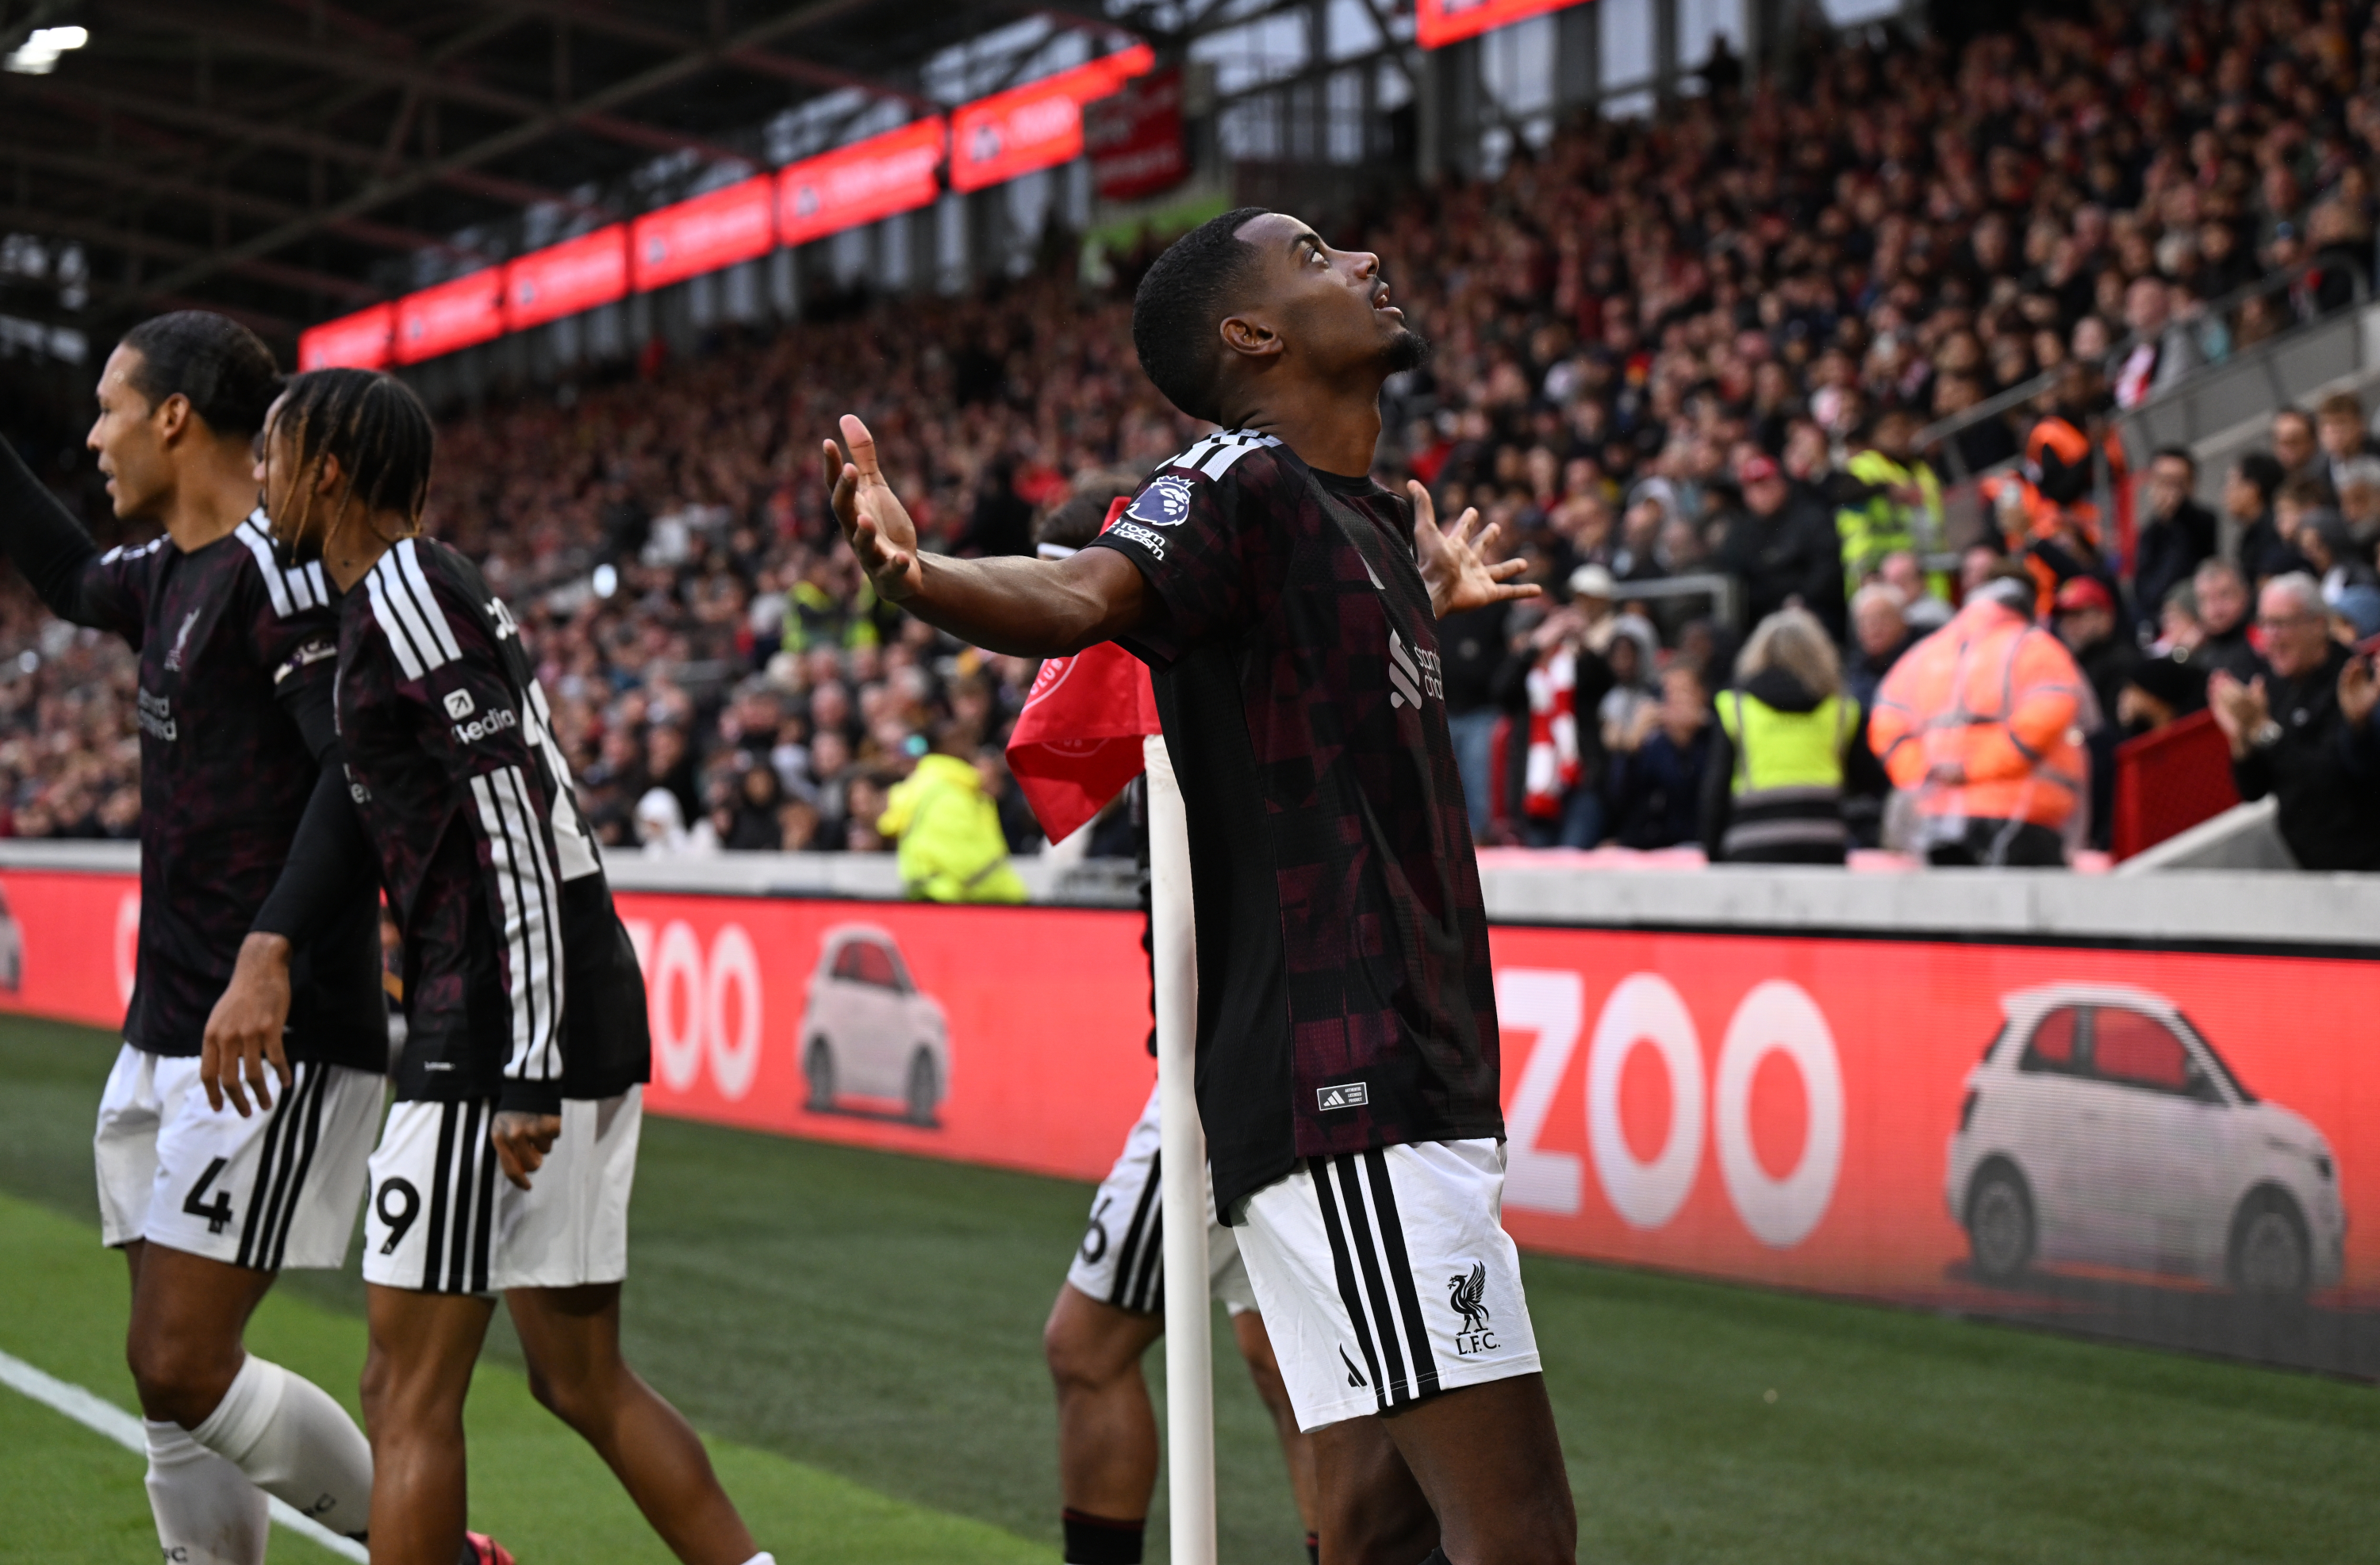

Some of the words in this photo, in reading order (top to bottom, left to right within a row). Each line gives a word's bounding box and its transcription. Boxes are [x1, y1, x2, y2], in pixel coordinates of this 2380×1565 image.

[1113, 527, 1165, 561] racism
[1120, 521, 1165, 547] room
[1496, 966, 1847, 1250] ZOO
[182, 1155, 233, 1235] 4
[1081, 1196, 1111, 1265] 6
[1455, 1332, 1501, 1356] L.F.C.
